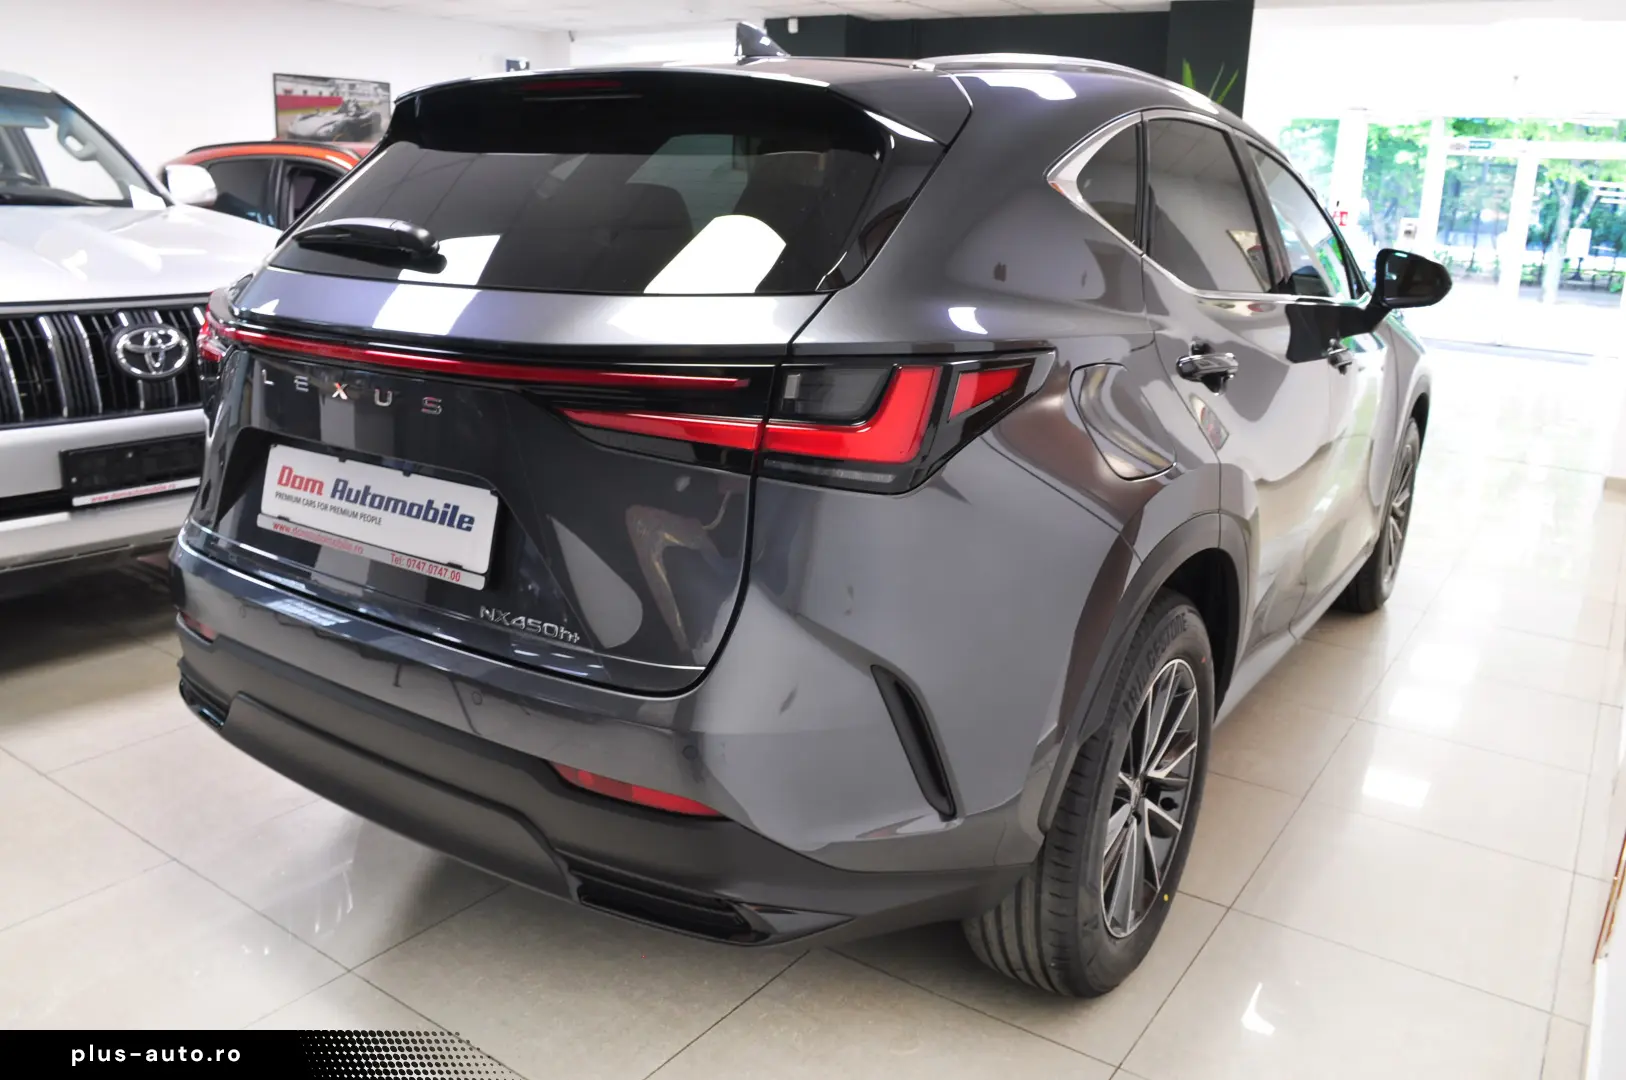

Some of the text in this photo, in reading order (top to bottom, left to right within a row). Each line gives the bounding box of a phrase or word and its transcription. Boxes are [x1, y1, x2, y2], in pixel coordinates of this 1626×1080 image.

[261, 369, 443, 415] LEXUS
[275, 491, 383, 526] PREMIUM CARS FOR PREMIUM PEOPLE
[277, 465, 475, 532] Dom Automobile
[406, 558, 461, 582] 0747.0747.00
